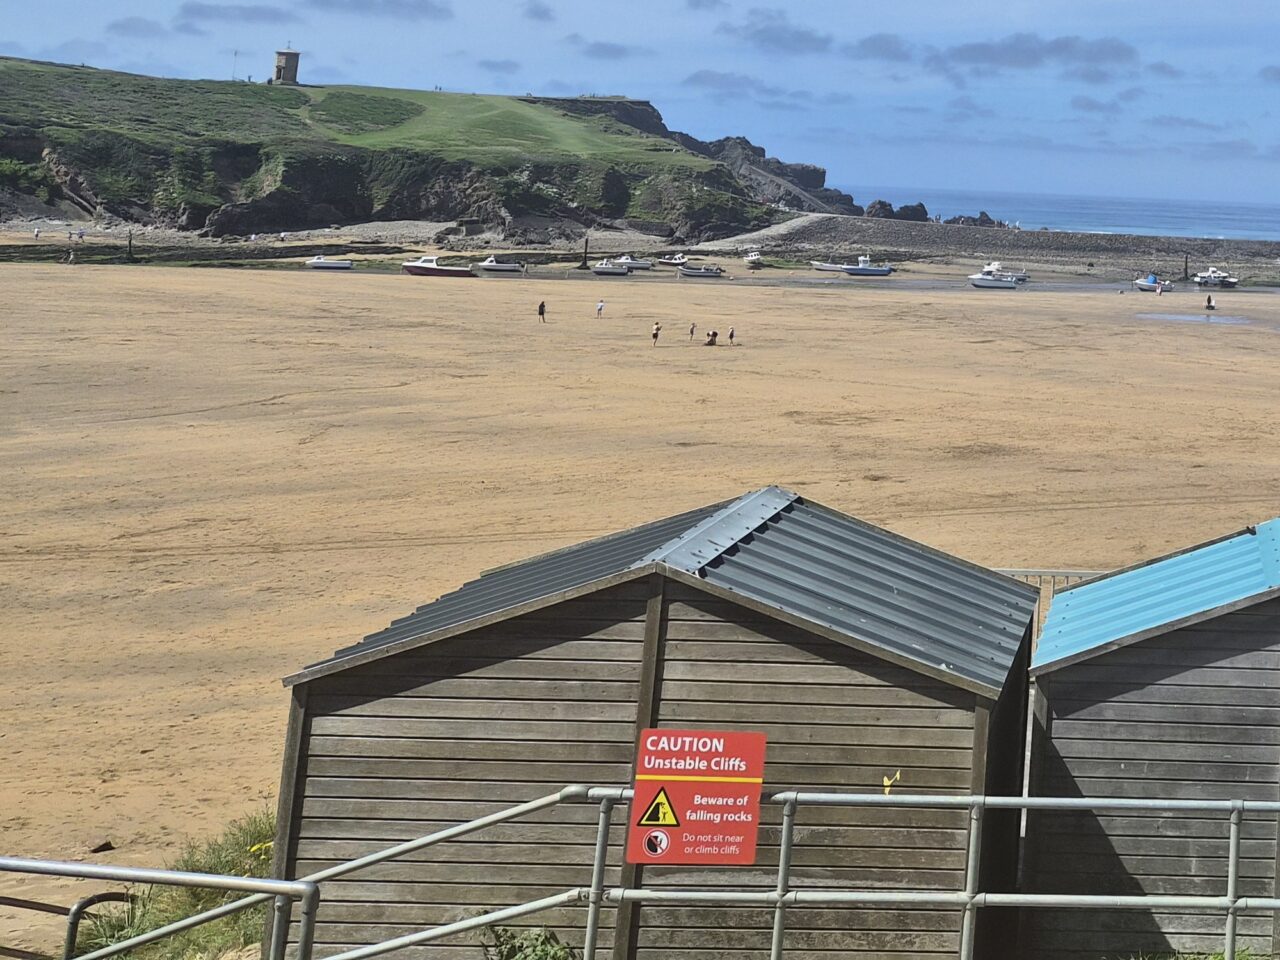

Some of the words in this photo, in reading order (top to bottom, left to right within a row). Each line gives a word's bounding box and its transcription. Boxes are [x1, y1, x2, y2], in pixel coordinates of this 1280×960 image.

[646, 736, 724, 753] CAUTION
[644, 756, 708, 770] Unstable
[711, 757, 747, 771] Cliffs
[693, 795, 734, 806] Beware
[736, 795, 749, 806] of
[686, 810, 721, 823] falling
[723, 811, 752, 822] rocks
[682, 833, 696, 842] Do
[697, 834, 711, 843] not
[713, 833, 723, 843] sit
[725, 835, 744, 843] near
[684, 846, 694, 854] or
[695, 845, 719, 854] climb
[720, 845, 740, 855] cliffs
